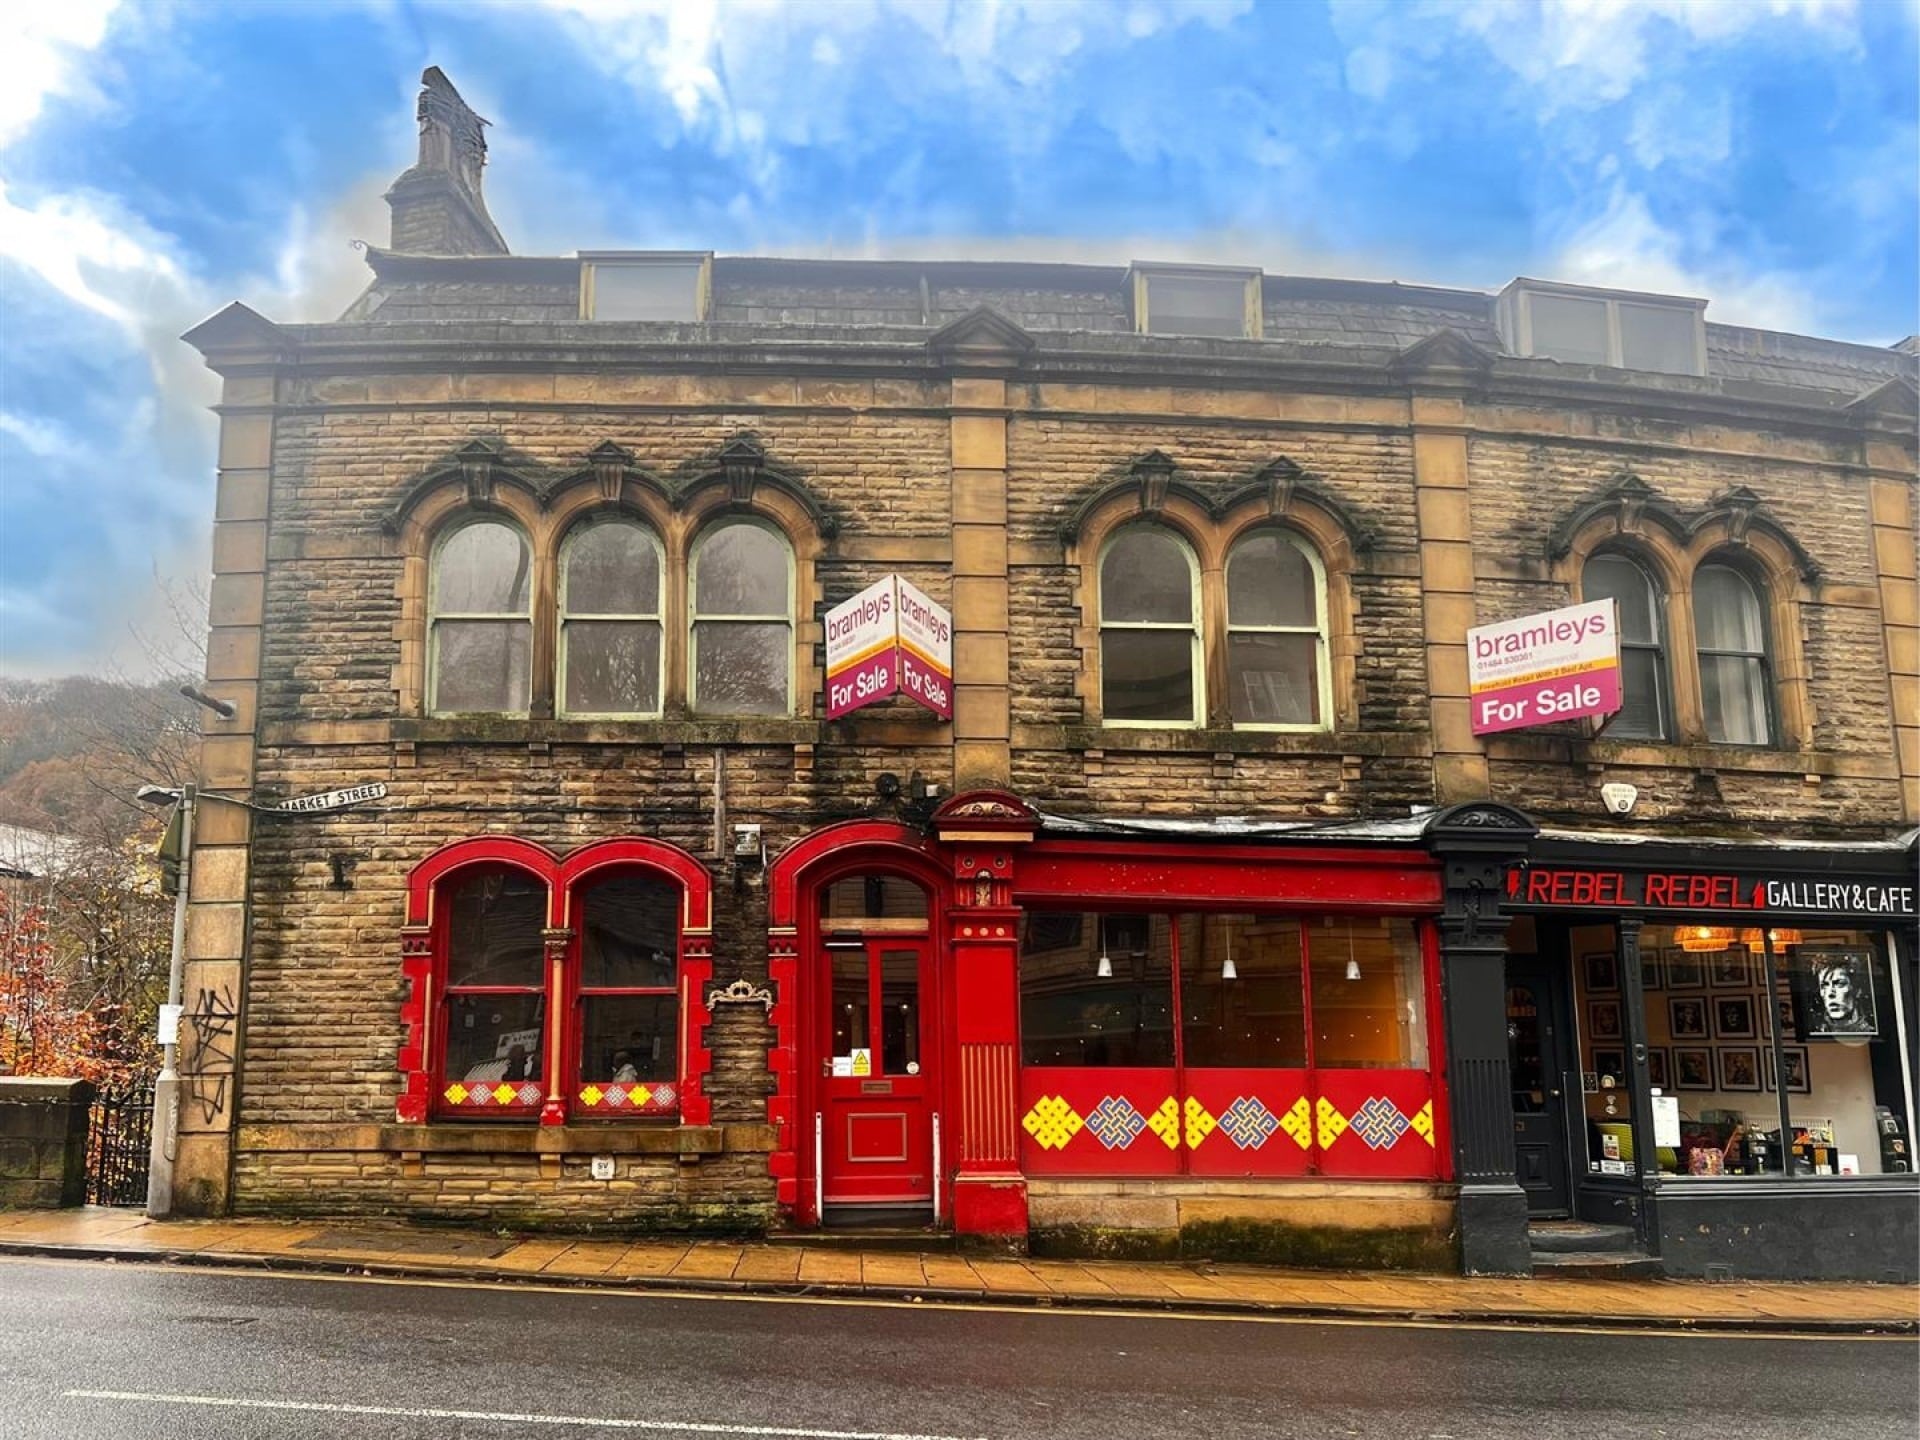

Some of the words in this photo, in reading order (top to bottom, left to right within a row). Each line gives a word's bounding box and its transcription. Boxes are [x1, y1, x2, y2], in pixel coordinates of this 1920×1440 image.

[829, 593, 890, 641] bramleys
[901, 587, 948, 642] bramleys
[1475, 614, 1606, 659] bramleys
[831, 682, 854, 711] For
[856, 665, 889, 699] Sale
[903, 659, 923, 693] For
[924, 673, 947, 709] Sale
[1481, 699, 1529, 726] For
[1535, 683, 1601, 716] Sale
[338, 784, 381, 804] STREET
[1527, 870, 1637, 905] REBEL
[1645, 873, 1752, 909] REBEL
[1767, 880, 1914, 913] GALLERY&CAFE
